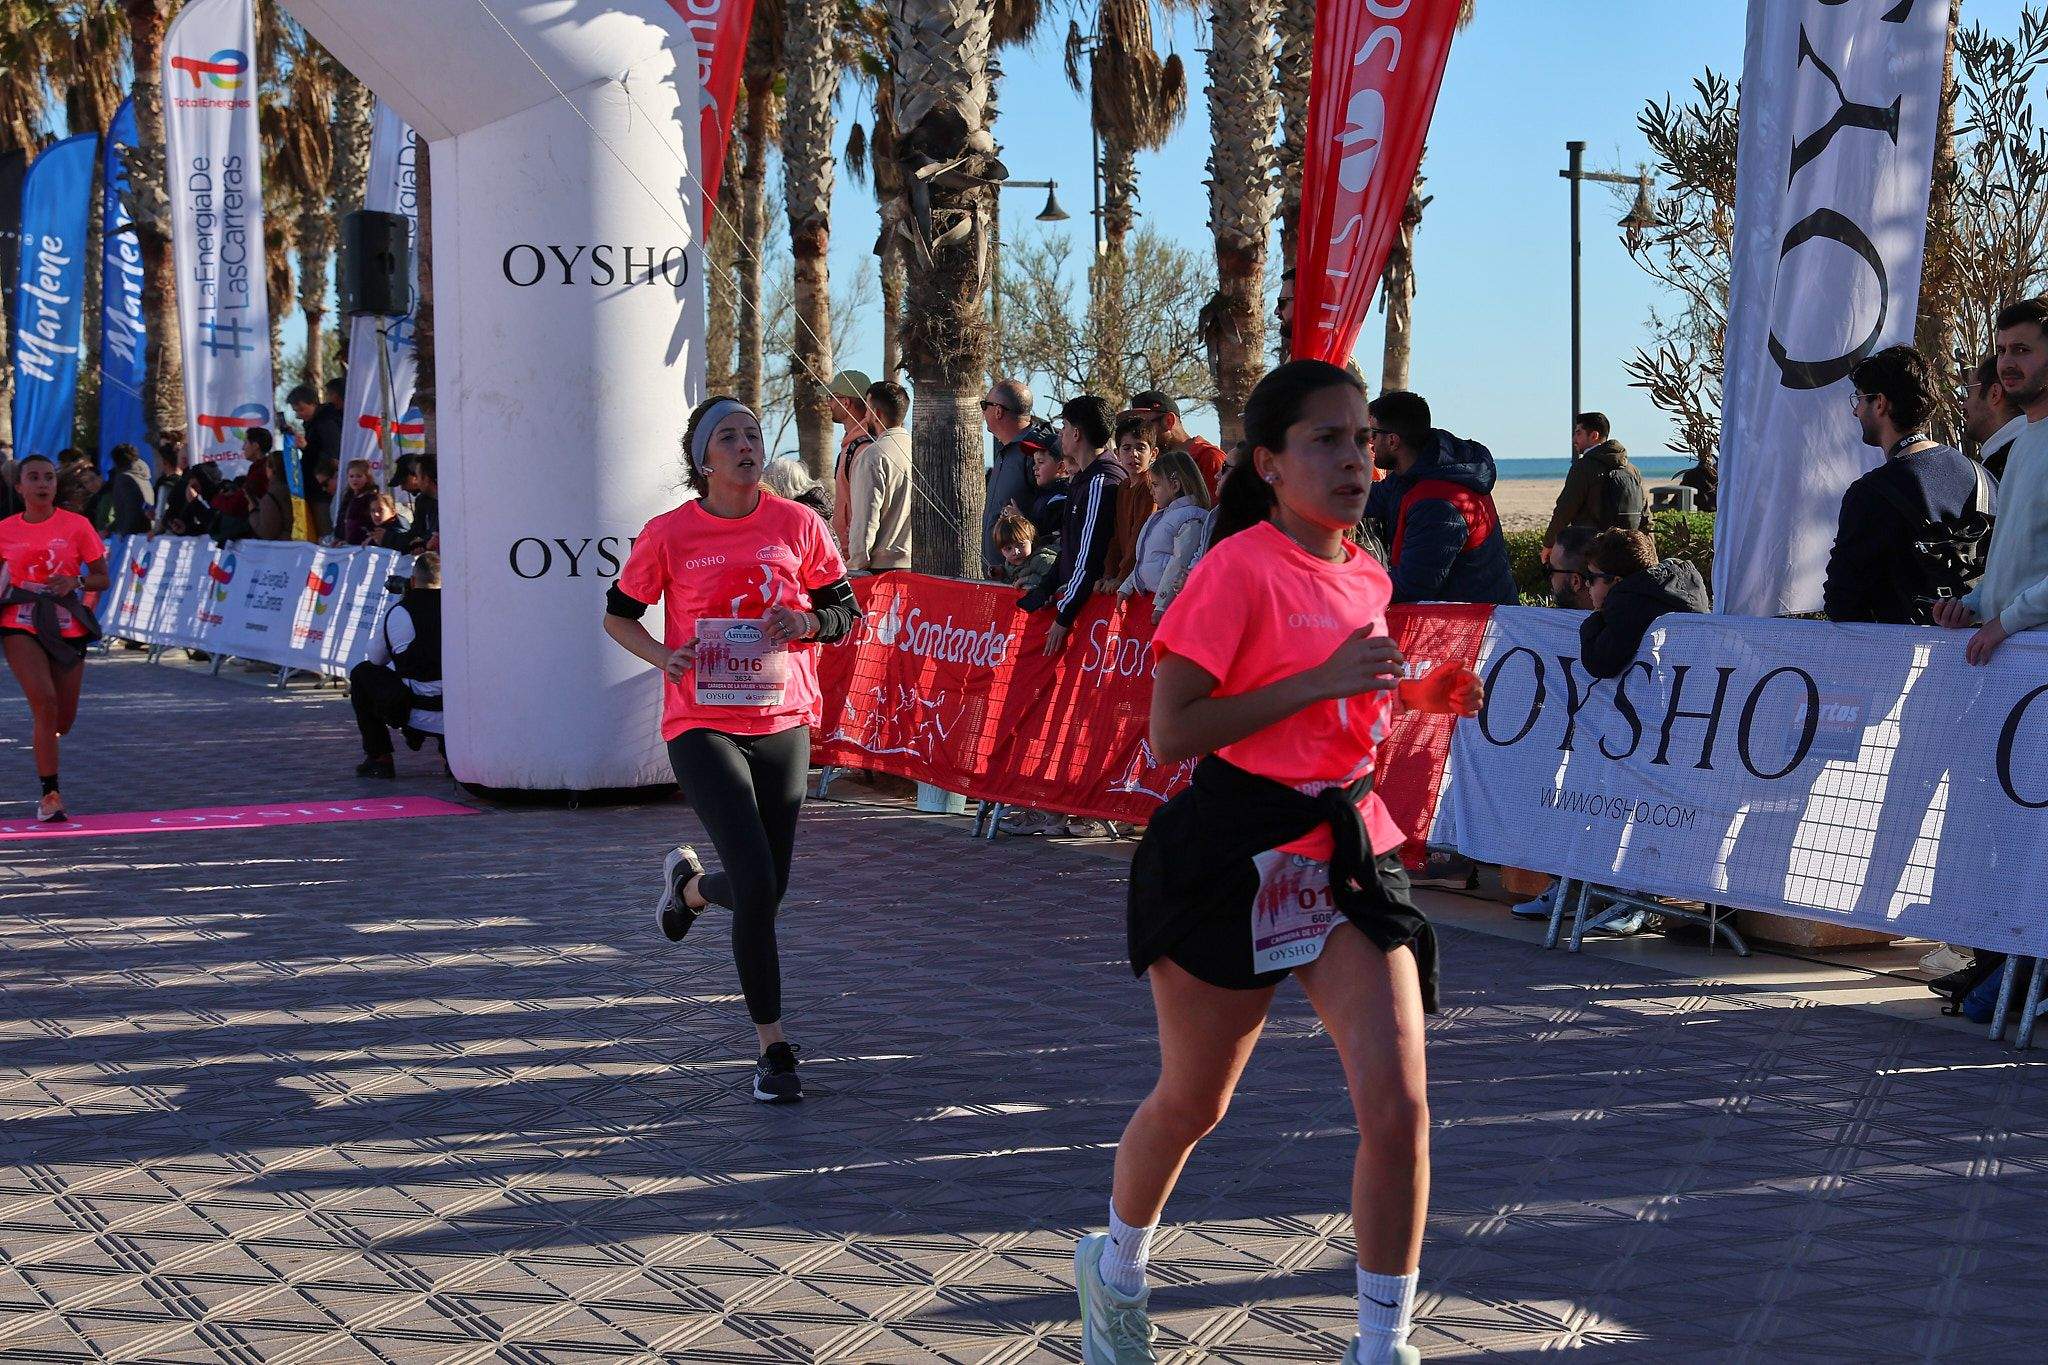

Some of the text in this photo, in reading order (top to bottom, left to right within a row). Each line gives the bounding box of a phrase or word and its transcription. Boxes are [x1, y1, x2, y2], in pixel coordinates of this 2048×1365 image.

[174, 98, 251, 111] TotalEnergies
[188, 156, 218, 311] LaEnergíaDe
[220, 154, 251, 310] LasCarreras
[502, 244, 688, 287] OYSHO
[18, 235, 78, 382] Marlene
[509, 536, 637, 579] OYS
[685, 555, 726, 570] OYSHO
[898, 607, 1016, 667] Santander
[1288, 612, 1339, 630] OYSHO
[728, 657, 763, 672] 016
[706, 692, 735, 700] OYSHO
[1480, 646, 1820, 780] OYSHO
[1540, 786, 1696, 831] WWW.OYSHO.COM
[1299, 885, 1334, 909] 01
[1269, 943, 1316, 961] OYSHO
